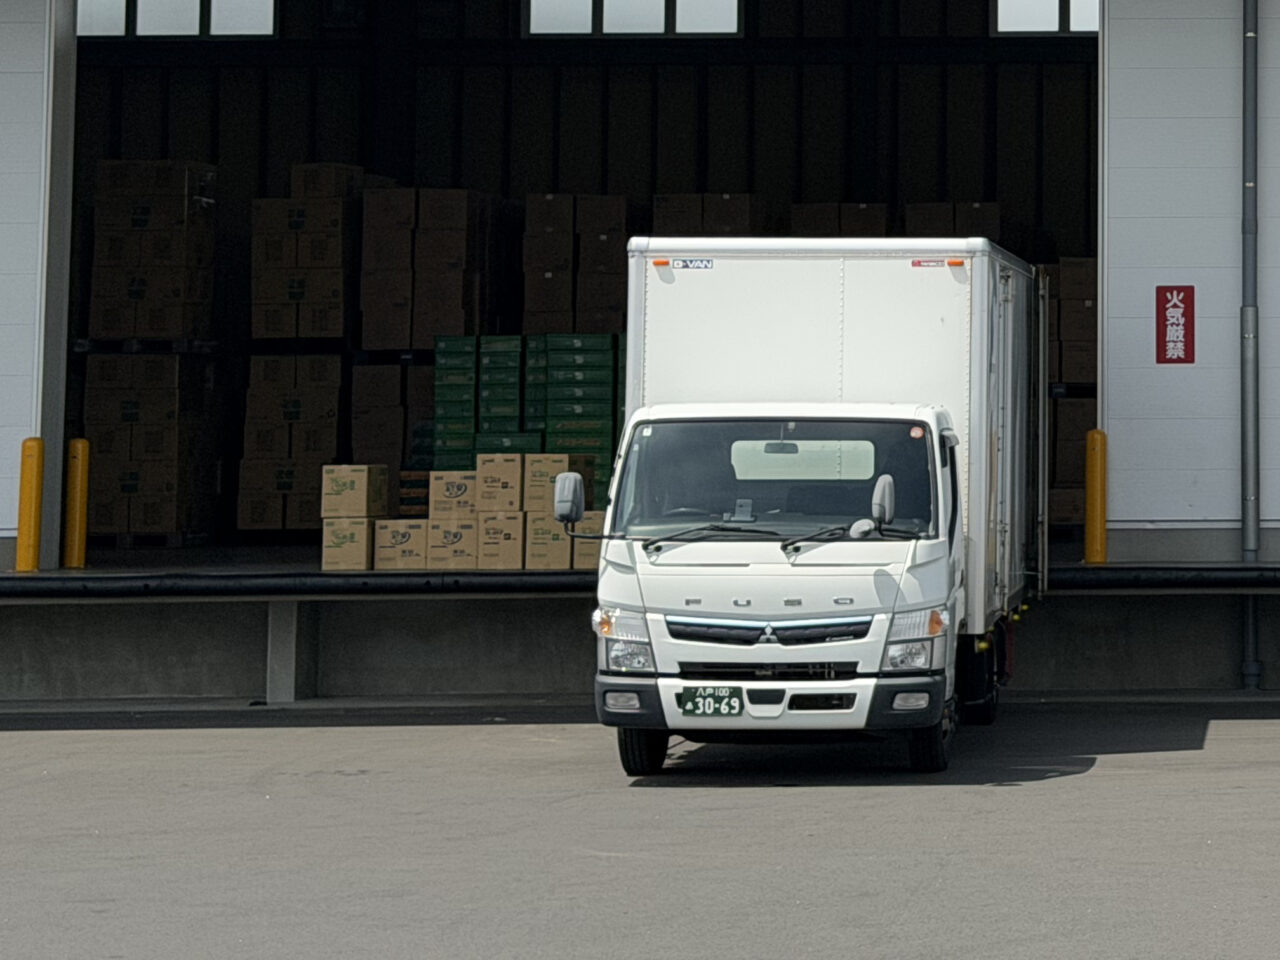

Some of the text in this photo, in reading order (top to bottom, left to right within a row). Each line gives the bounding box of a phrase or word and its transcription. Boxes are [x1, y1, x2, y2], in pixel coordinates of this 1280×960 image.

[1165, 290, 1185, 359] 火気厳禁
[685, 598, 854, 607] FUSO
